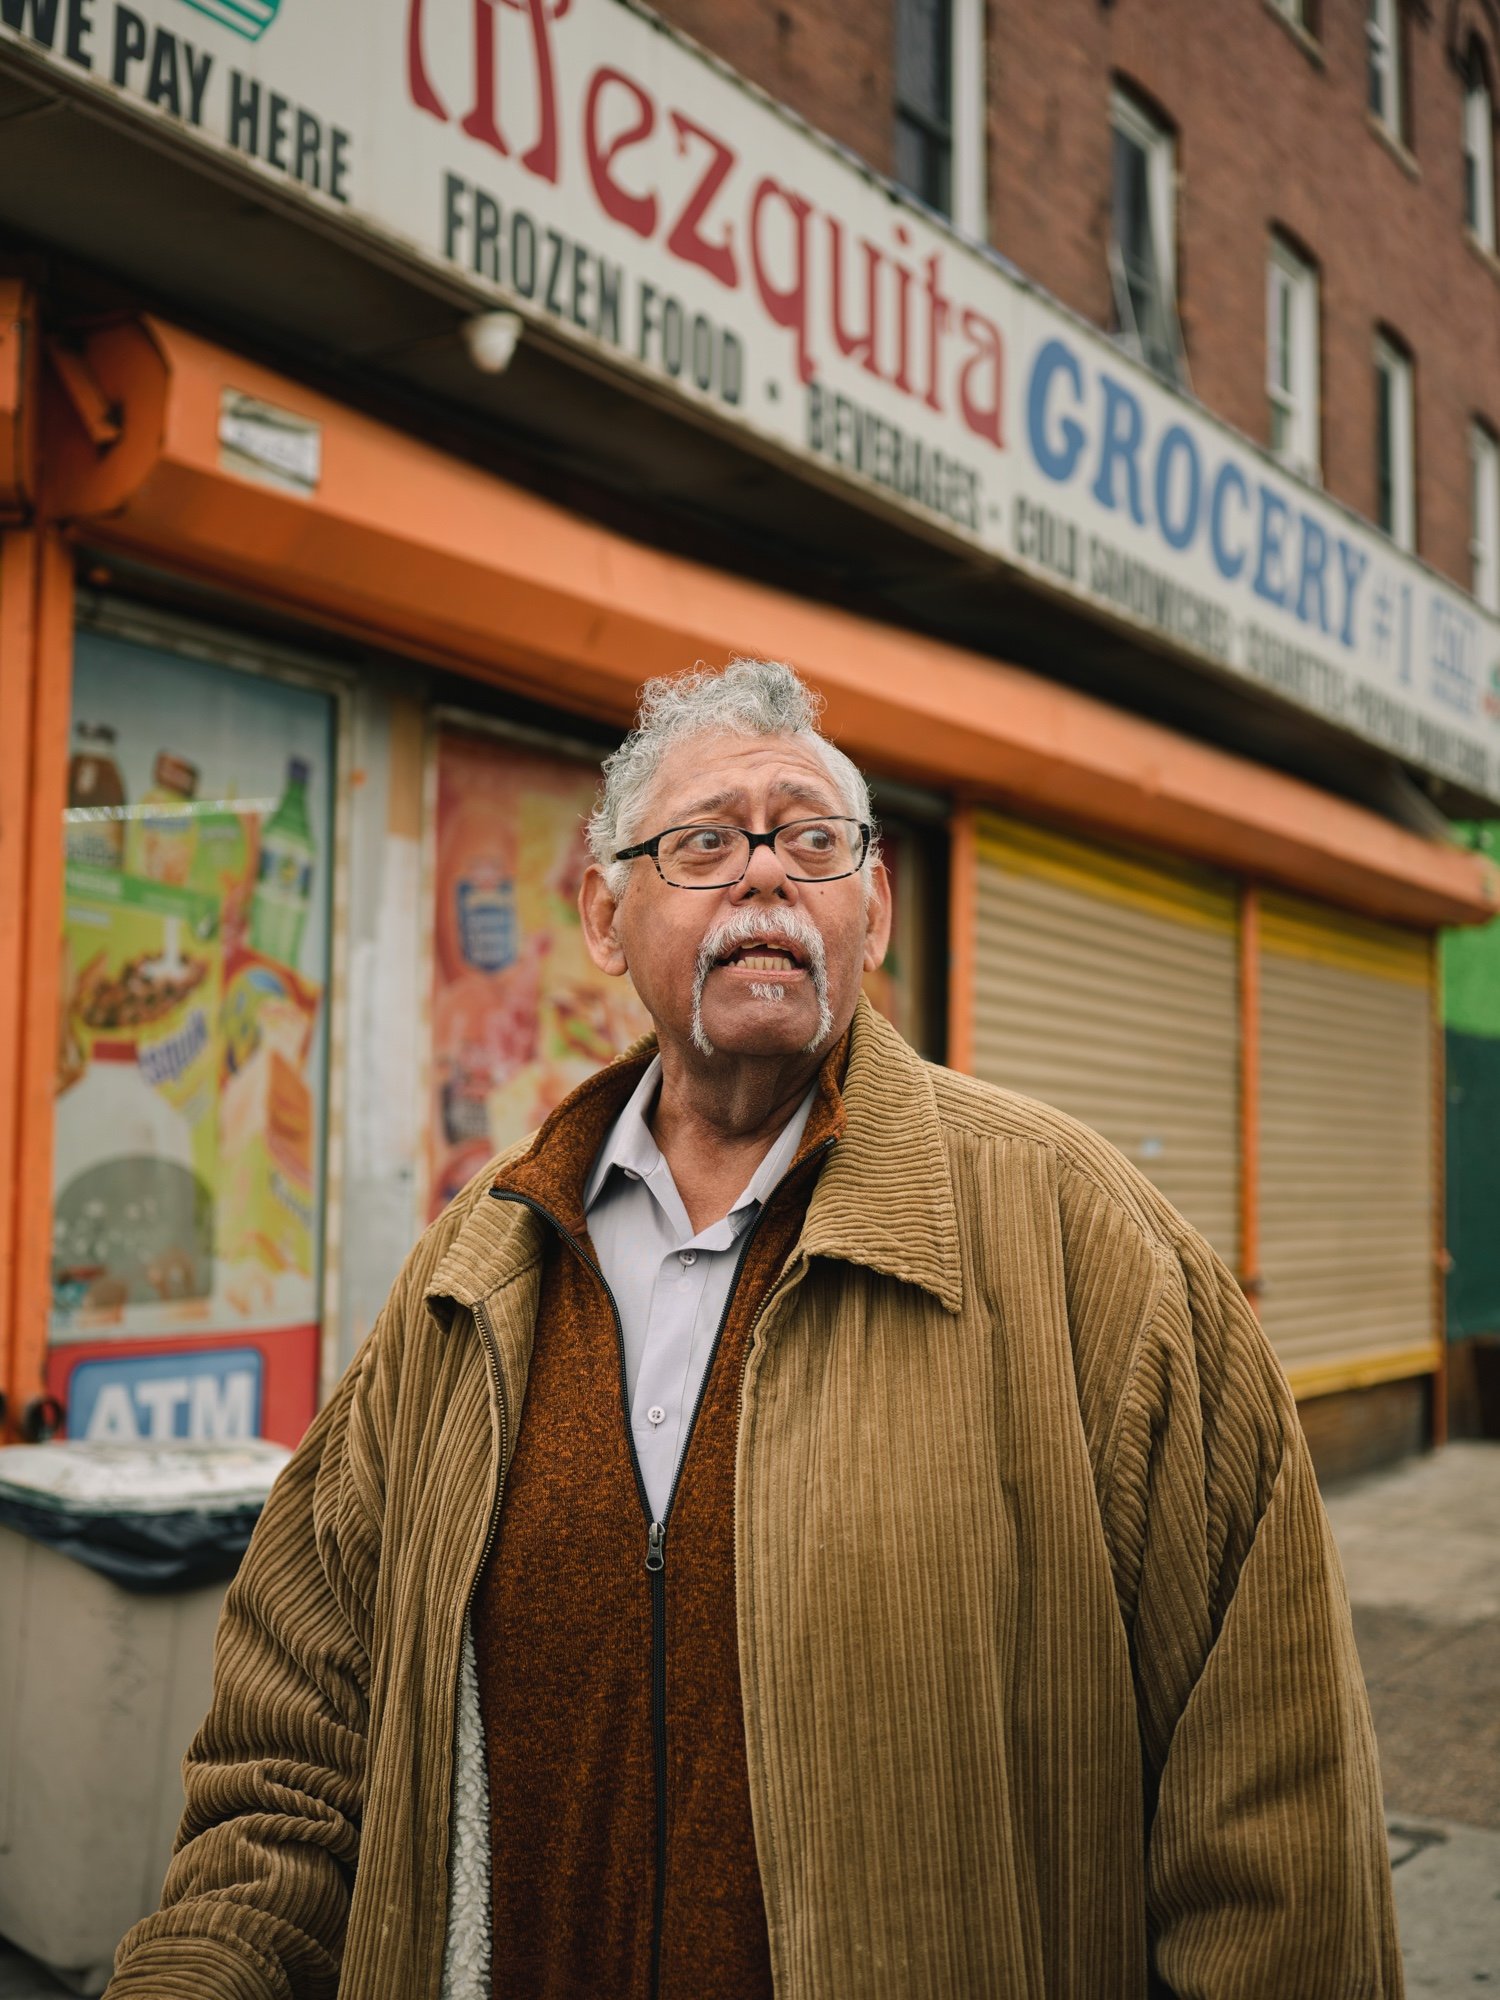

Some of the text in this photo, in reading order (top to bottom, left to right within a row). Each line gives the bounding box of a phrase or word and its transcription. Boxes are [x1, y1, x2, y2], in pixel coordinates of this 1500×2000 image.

[110, 3, 212, 125] PAY
[228, 70, 351, 202] HERE
[444, 170, 622, 347] FROZEN
[640, 281, 743, 406] FOOD
[808, 381, 981, 532] BEVERAGES
[1026, 340, 1369, 651] GROCERY
[86, 1372, 257, 1440] ATM
